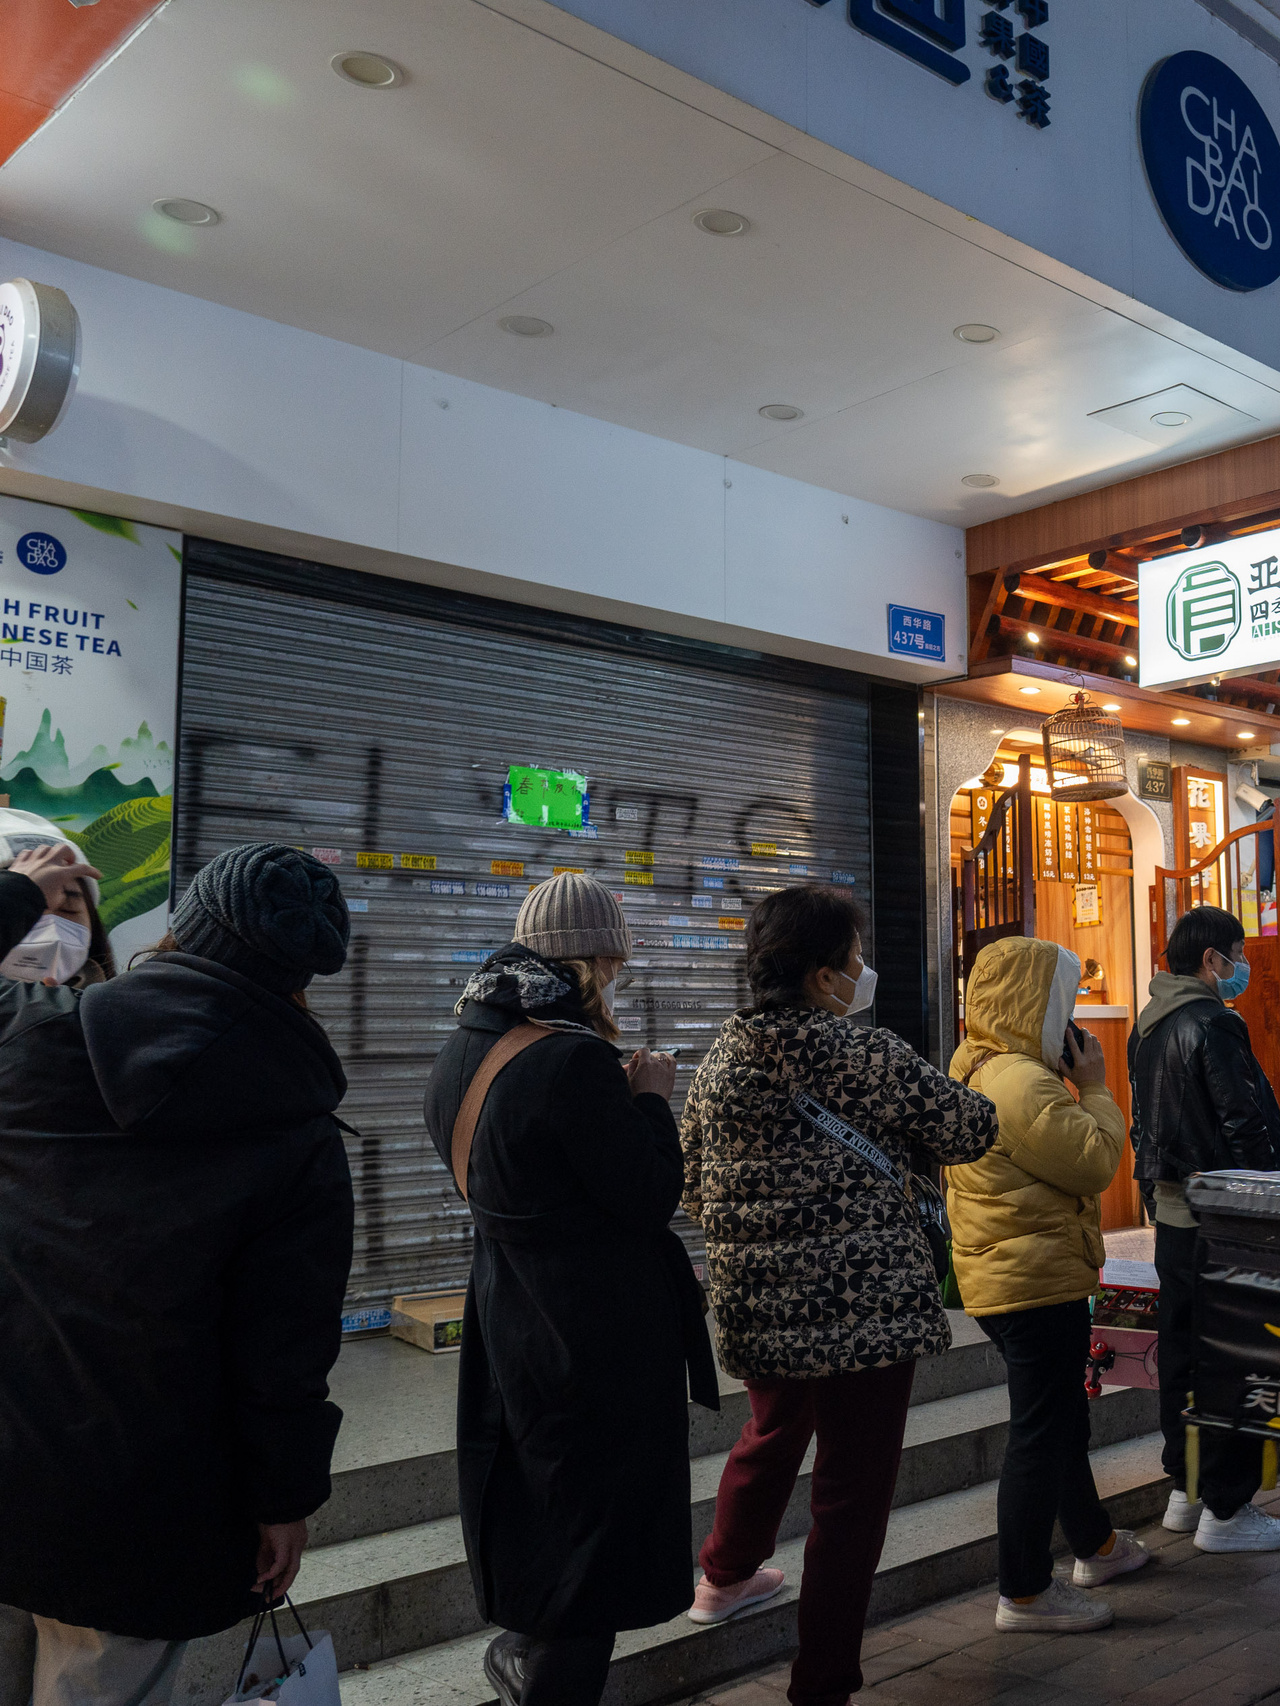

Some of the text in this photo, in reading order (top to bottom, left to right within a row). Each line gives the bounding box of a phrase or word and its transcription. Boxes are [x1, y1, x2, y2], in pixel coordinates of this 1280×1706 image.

[1180, 85, 1262, 175] CHA
[1203, 136, 1259, 208] BAI
[1186, 156, 1273, 250] DAO
[26, 538, 56, 552] CHA
[27, 552, 59, 568] DAO
[29, 602, 105, 630] FRUIT
[902, 615, 932, 632] 西华路
[2, 622, 122, 657] NESE TEA
[893, 630, 926, 650] 437号
[0, 647, 74, 676] 中国茶
[1145, 780, 1166, 794] 437
[817, 1112, 849, 1138] DOIRO
[848, 1134, 892, 1173] CHRISTIAN
